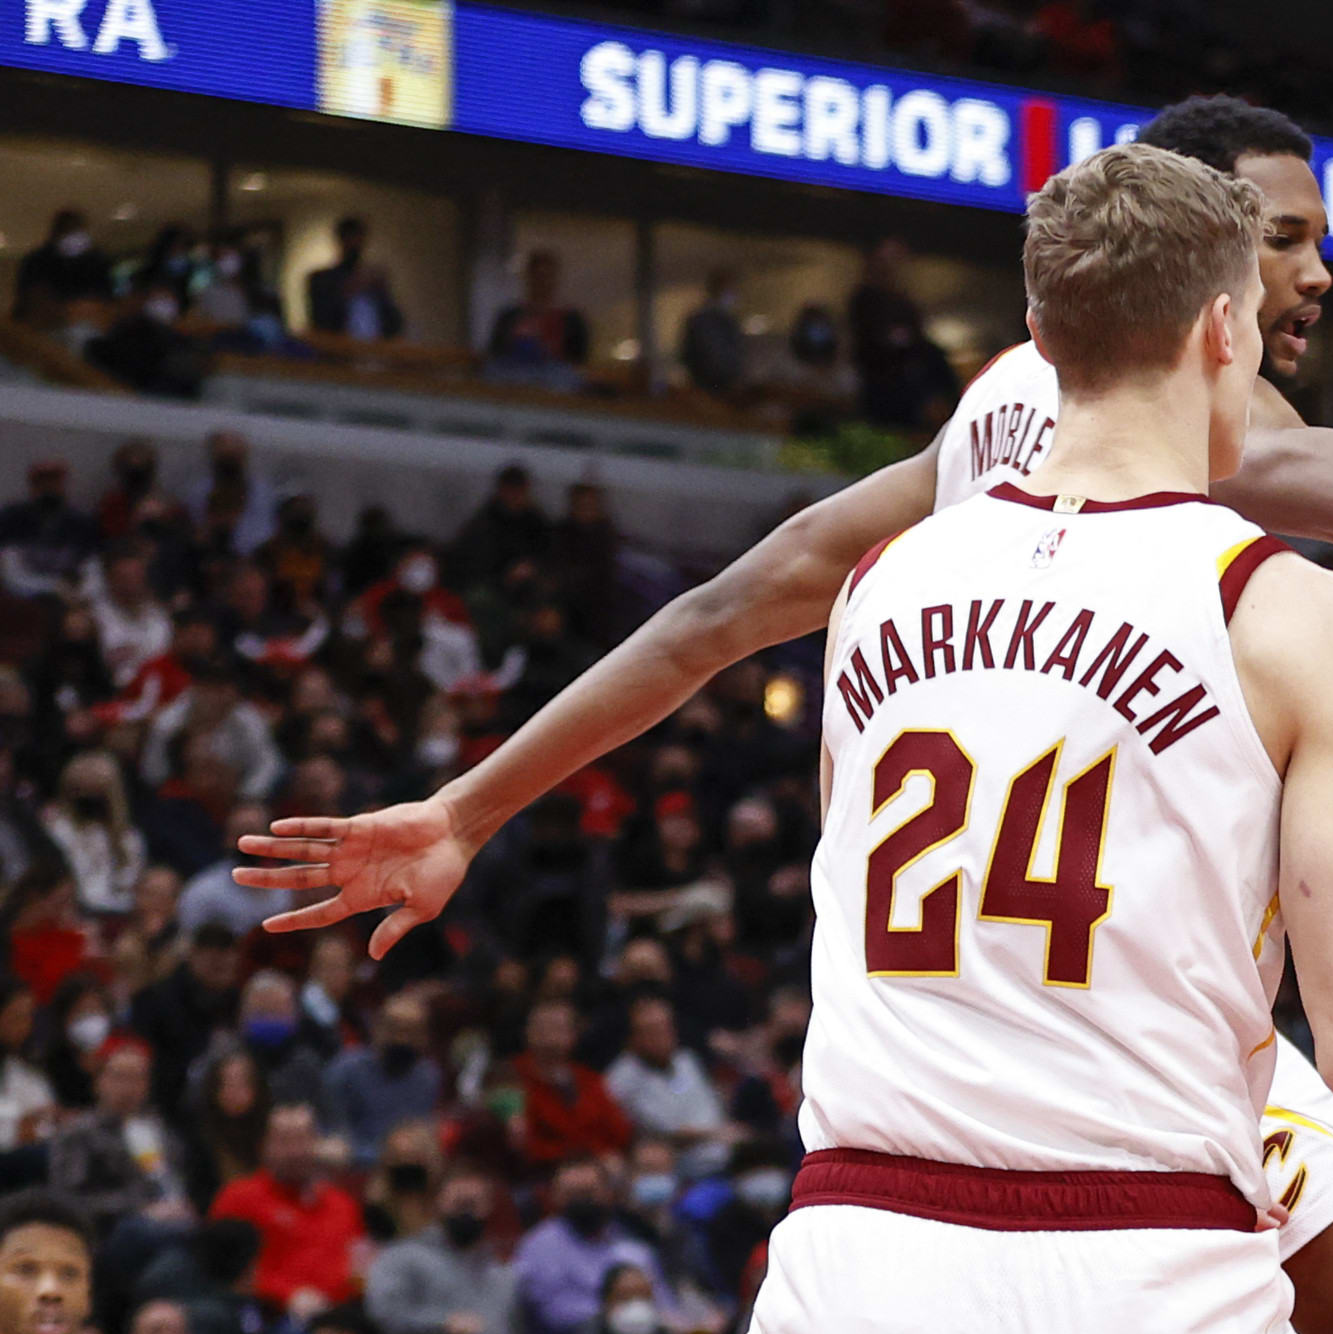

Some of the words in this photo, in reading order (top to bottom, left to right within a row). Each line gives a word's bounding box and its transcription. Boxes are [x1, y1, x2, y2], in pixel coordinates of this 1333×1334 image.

[579, 41, 1012, 187] SUPERIOR
[836, 598, 1221, 756] MARKKANEN
[865, 729, 1118, 990] 24
